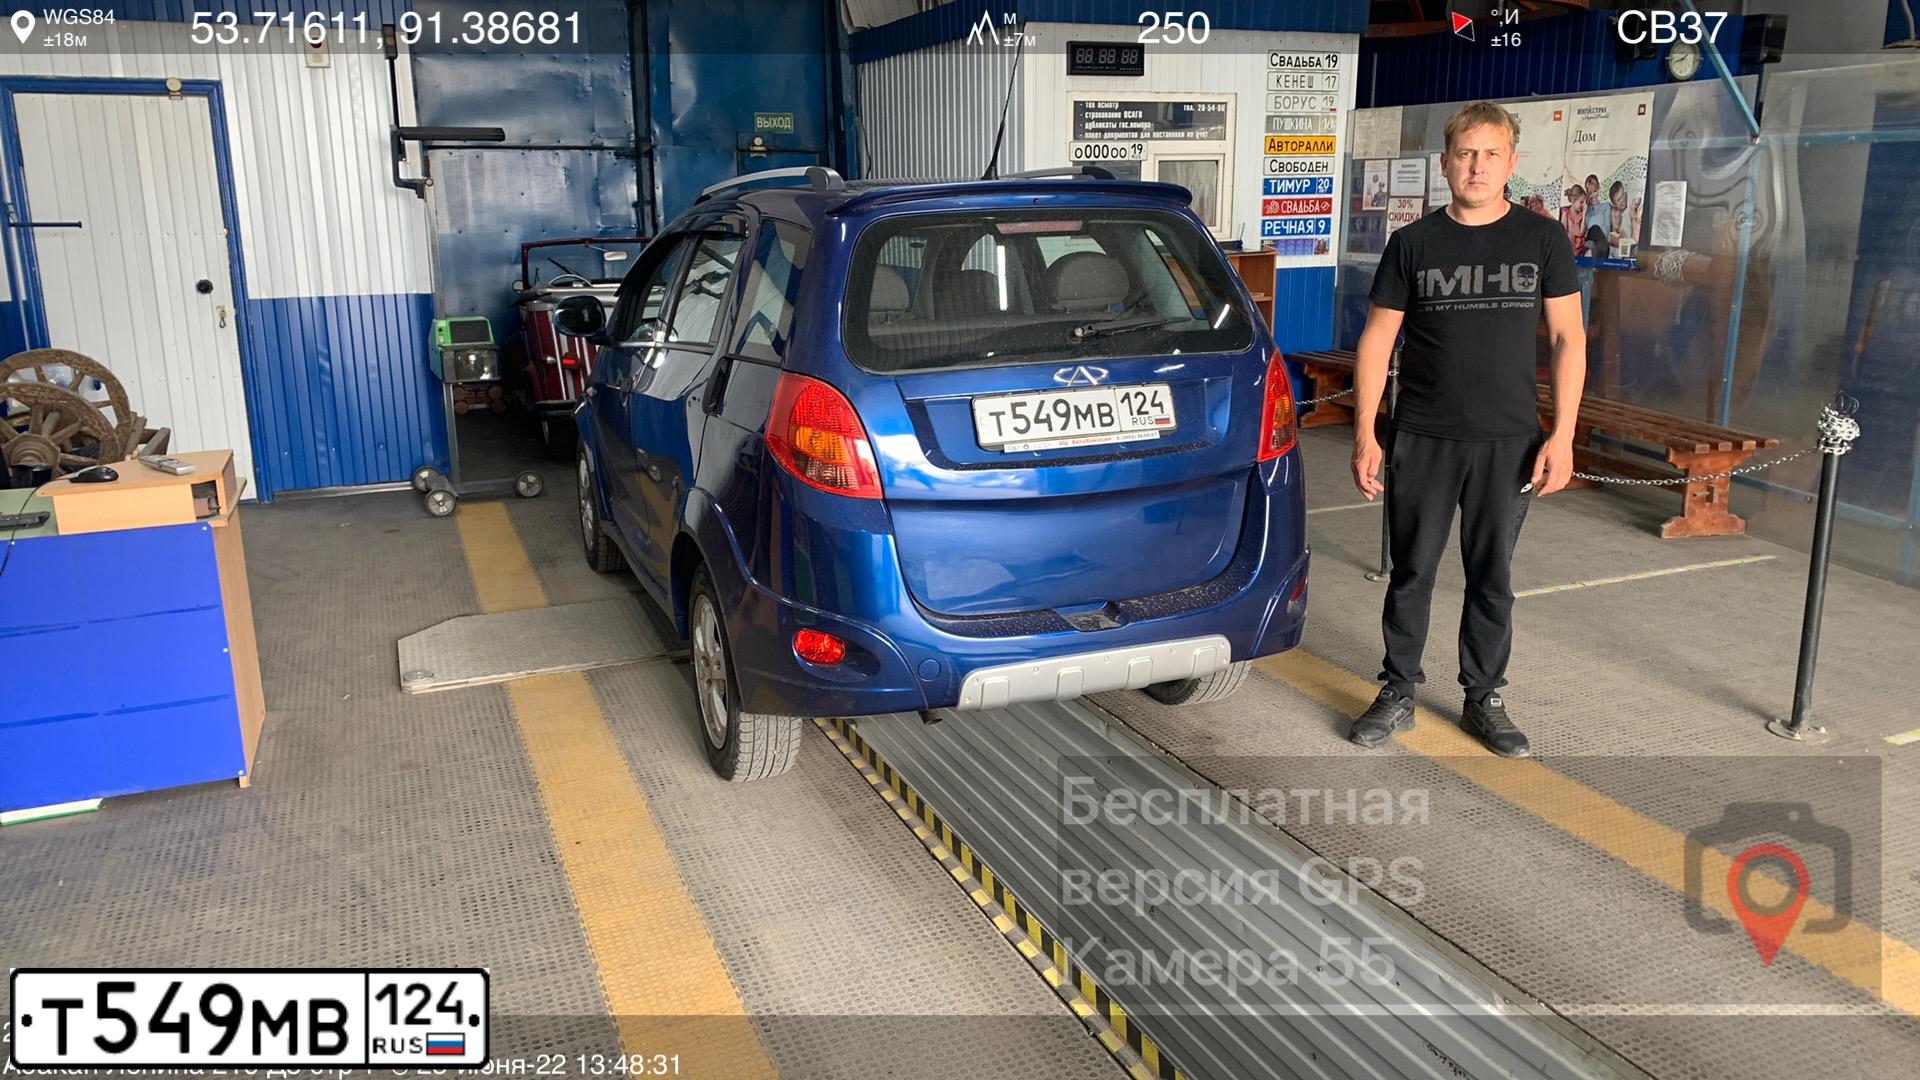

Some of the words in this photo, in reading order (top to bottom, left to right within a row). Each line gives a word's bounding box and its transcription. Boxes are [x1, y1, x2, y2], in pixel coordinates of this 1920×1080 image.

[1325, 54, 1338, 69] 19
[1276, 74, 1314, 88] КЕНЕШ
[1324, 75, 1337, 89] 17
[1274, 95, 1317, 110] БОРУС
[1322, 95, 1335, 107] 19
[1123, 110, 1143, 119] ОСАГО
[756, 116, 792, 130] ВЫХОД
[1272, 117, 1313, 130] ПУШКИНА
[1573, 129, 1597, 145] Дом
[1130, 143, 1144, 155] 19
[1268, 179, 1311, 193] ТИМУР
[1317, 178, 1330, 189] 20
[1280, 199, 1320, 214] СВАДЬБА
[1397, 199, 1414, 209] 30%
[1264, 219, 1314, 235] РЕЧНАЯ
[1317, 219, 1326, 234] 9
[1435, 304, 1452, 312] MY
[1454, 303, 1499, 311] HUMBLE
[1119, 390, 1165, 416] 124
[1131, 416, 1153, 426] RUS
